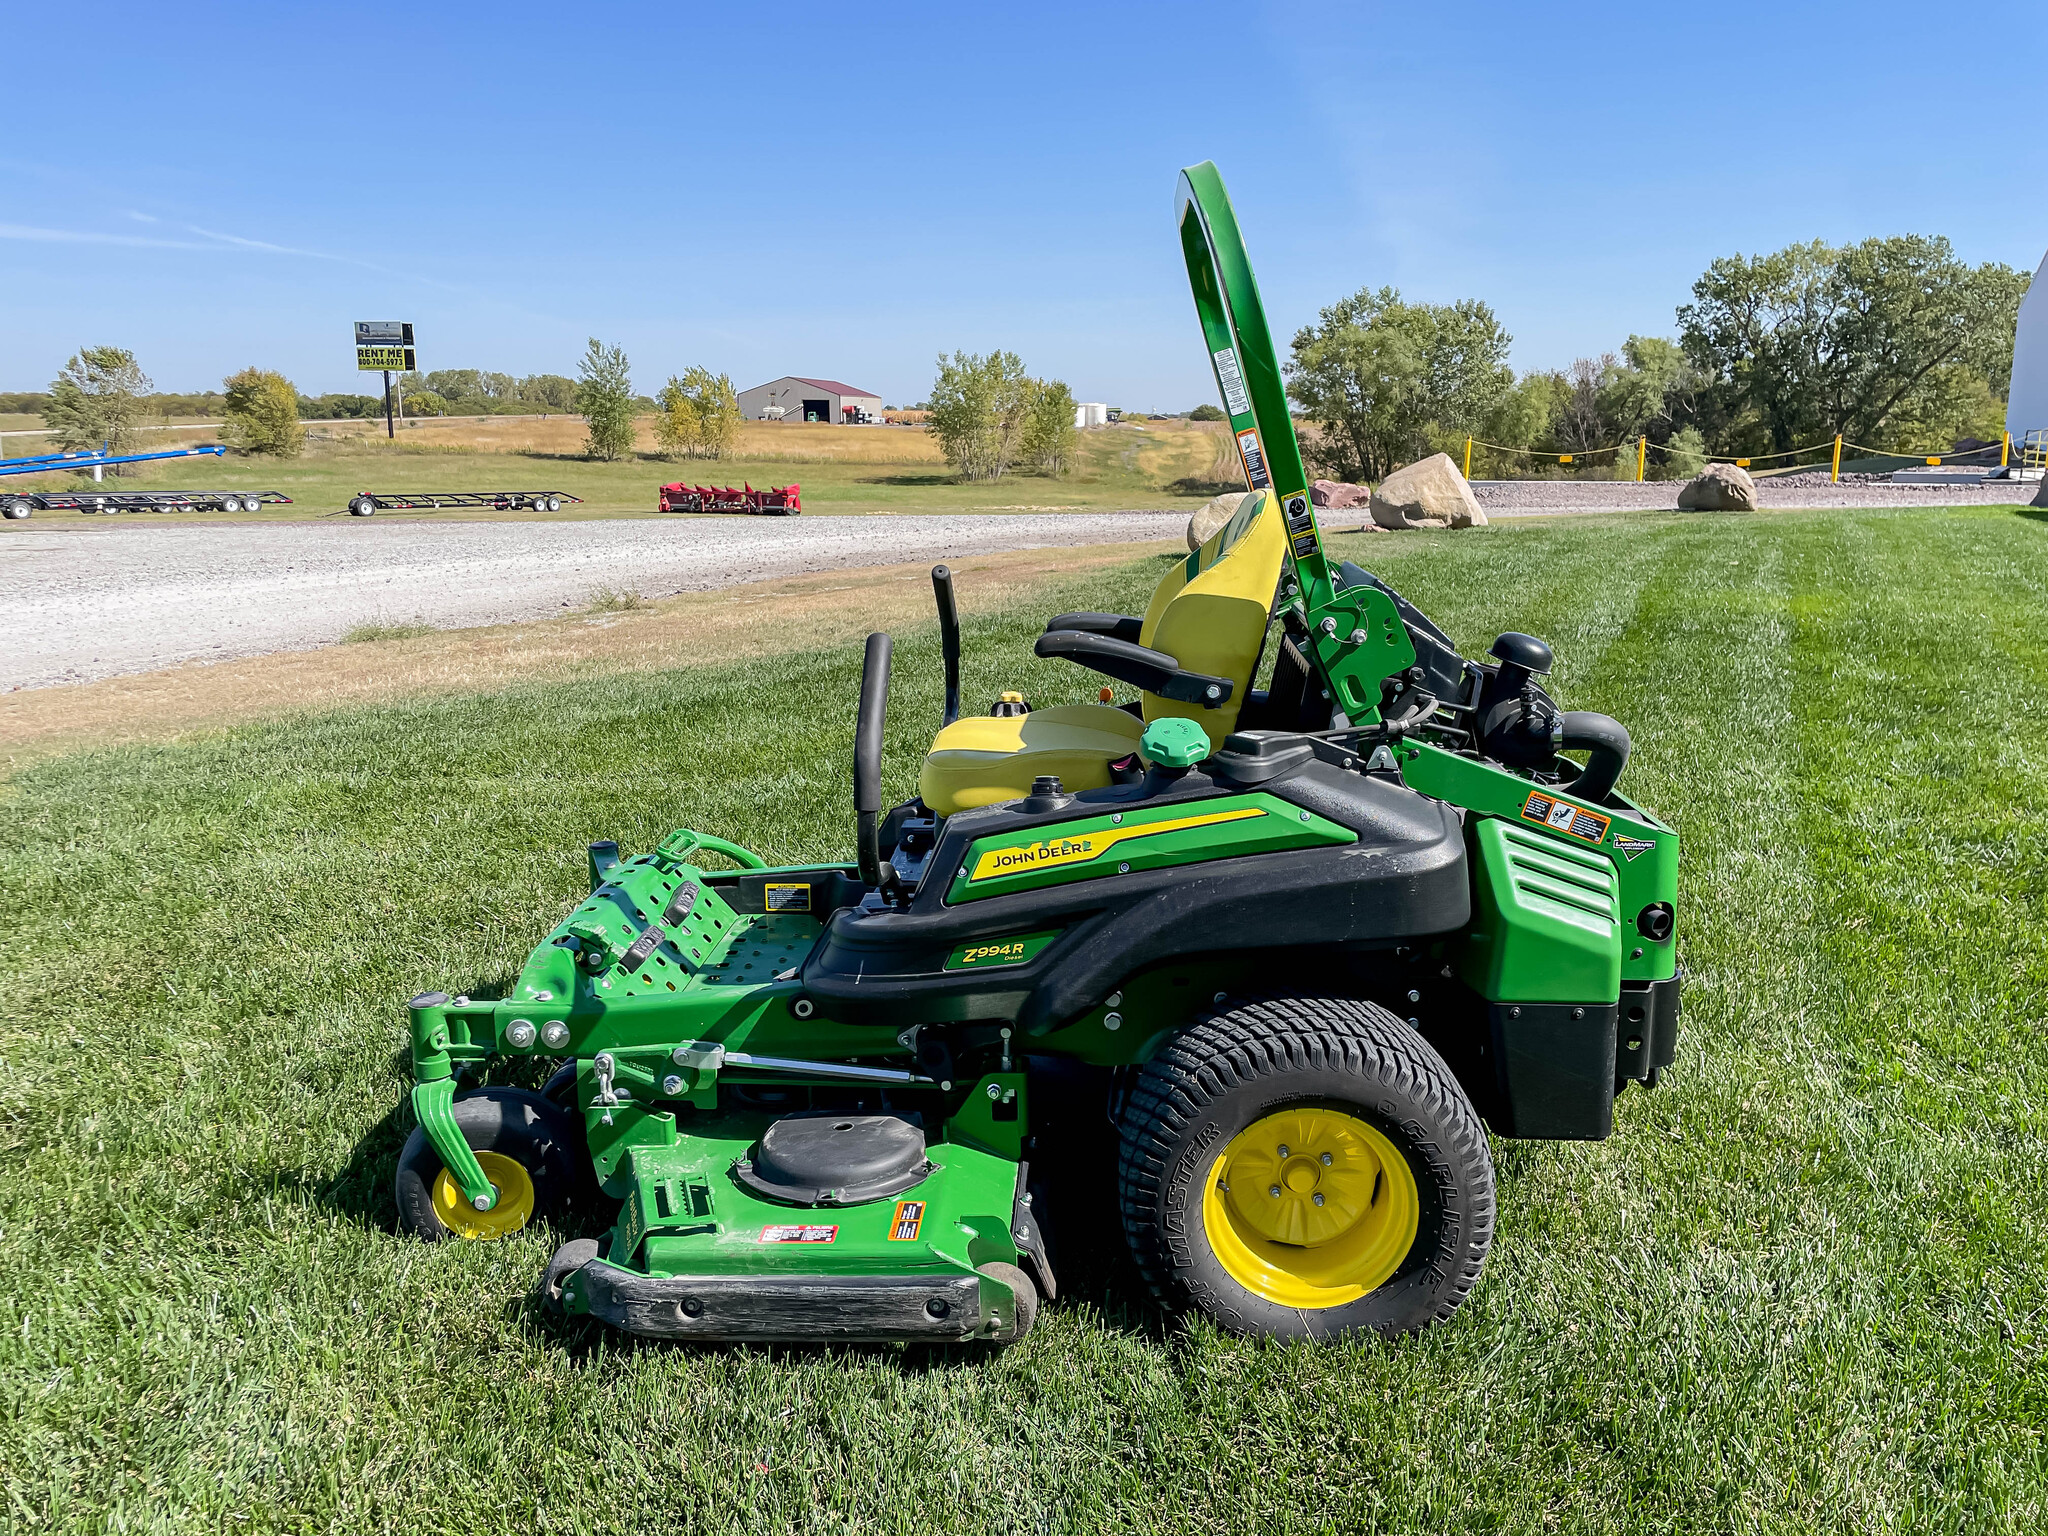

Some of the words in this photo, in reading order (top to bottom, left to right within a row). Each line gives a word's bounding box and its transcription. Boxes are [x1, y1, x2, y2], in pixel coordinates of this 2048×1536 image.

[358, 349, 384, 357] RENT
[388, 349, 402, 357] ME
[992, 851, 1035, 868] JOHN
[1038, 842, 1092, 860] DEER
[1166, 1121, 1222, 1267] MASTER
[1400, 1118, 1461, 1294] CARLISLE
